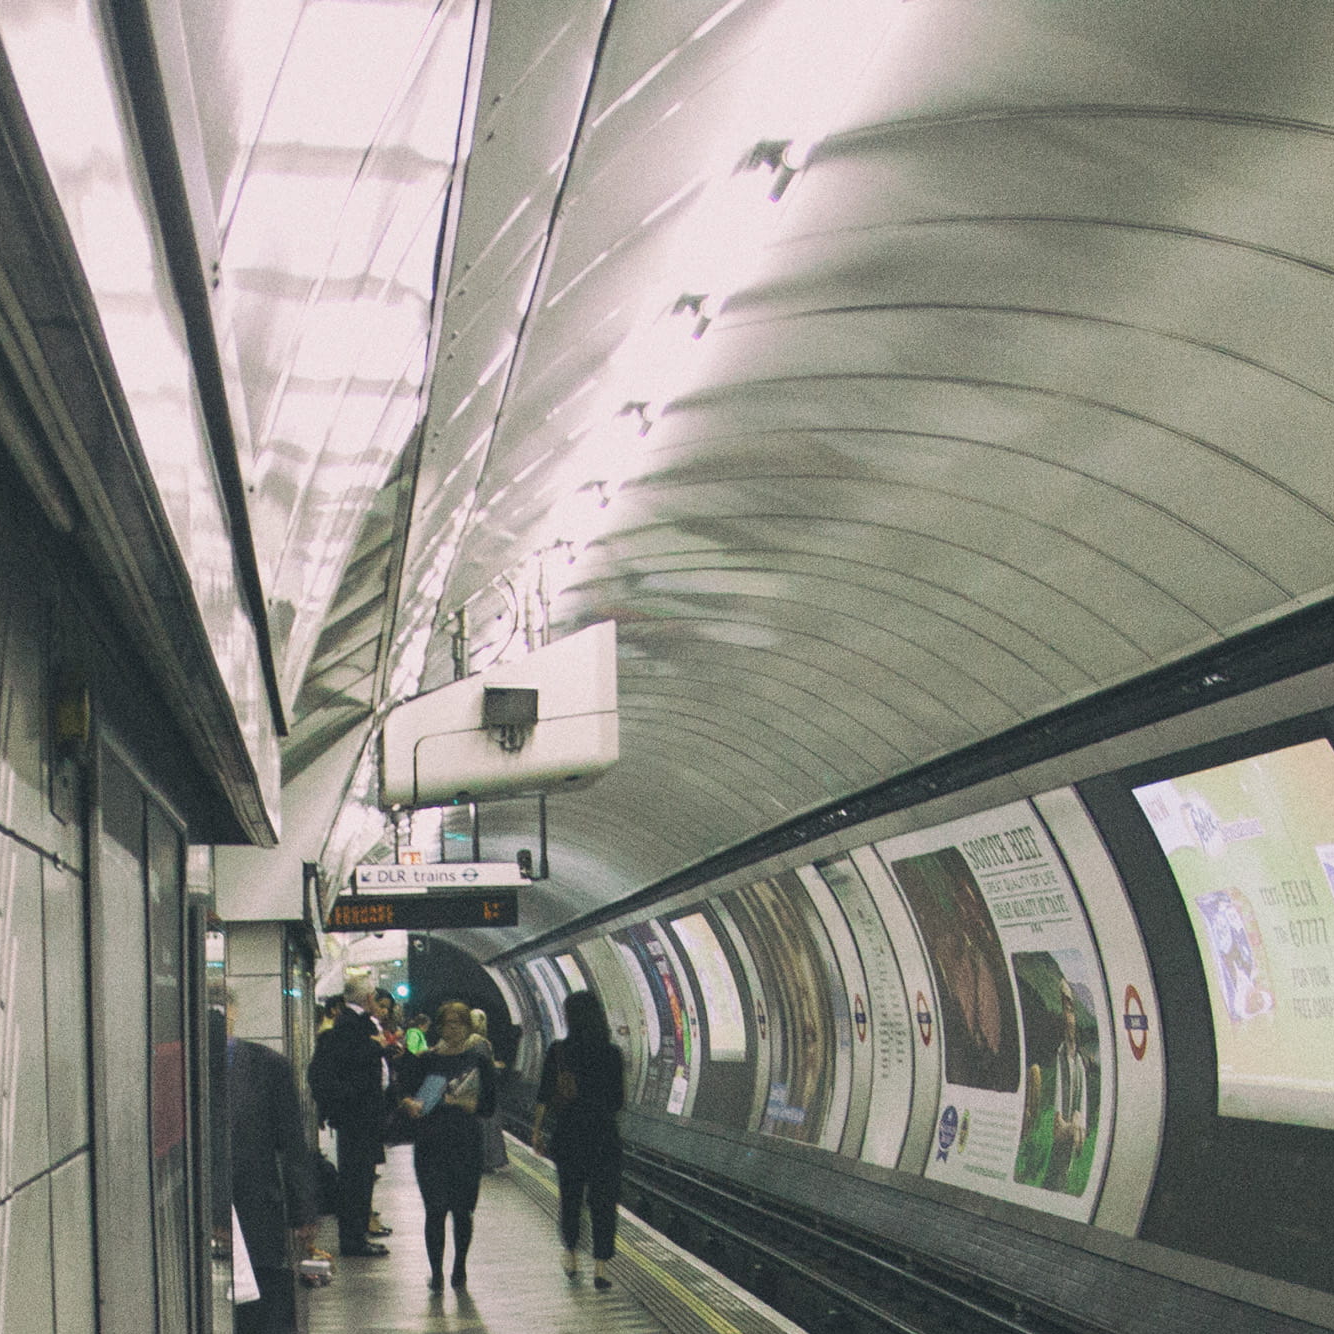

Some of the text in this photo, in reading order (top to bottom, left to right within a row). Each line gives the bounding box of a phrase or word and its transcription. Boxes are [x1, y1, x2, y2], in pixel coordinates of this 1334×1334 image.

[962, 826, 1043, 870] SCOTCH BEEF
[377, 869, 457, 883] DLR trains
[1281, 879, 1319, 908] FELIX
[1289, 917, 1329, 948] 67777
